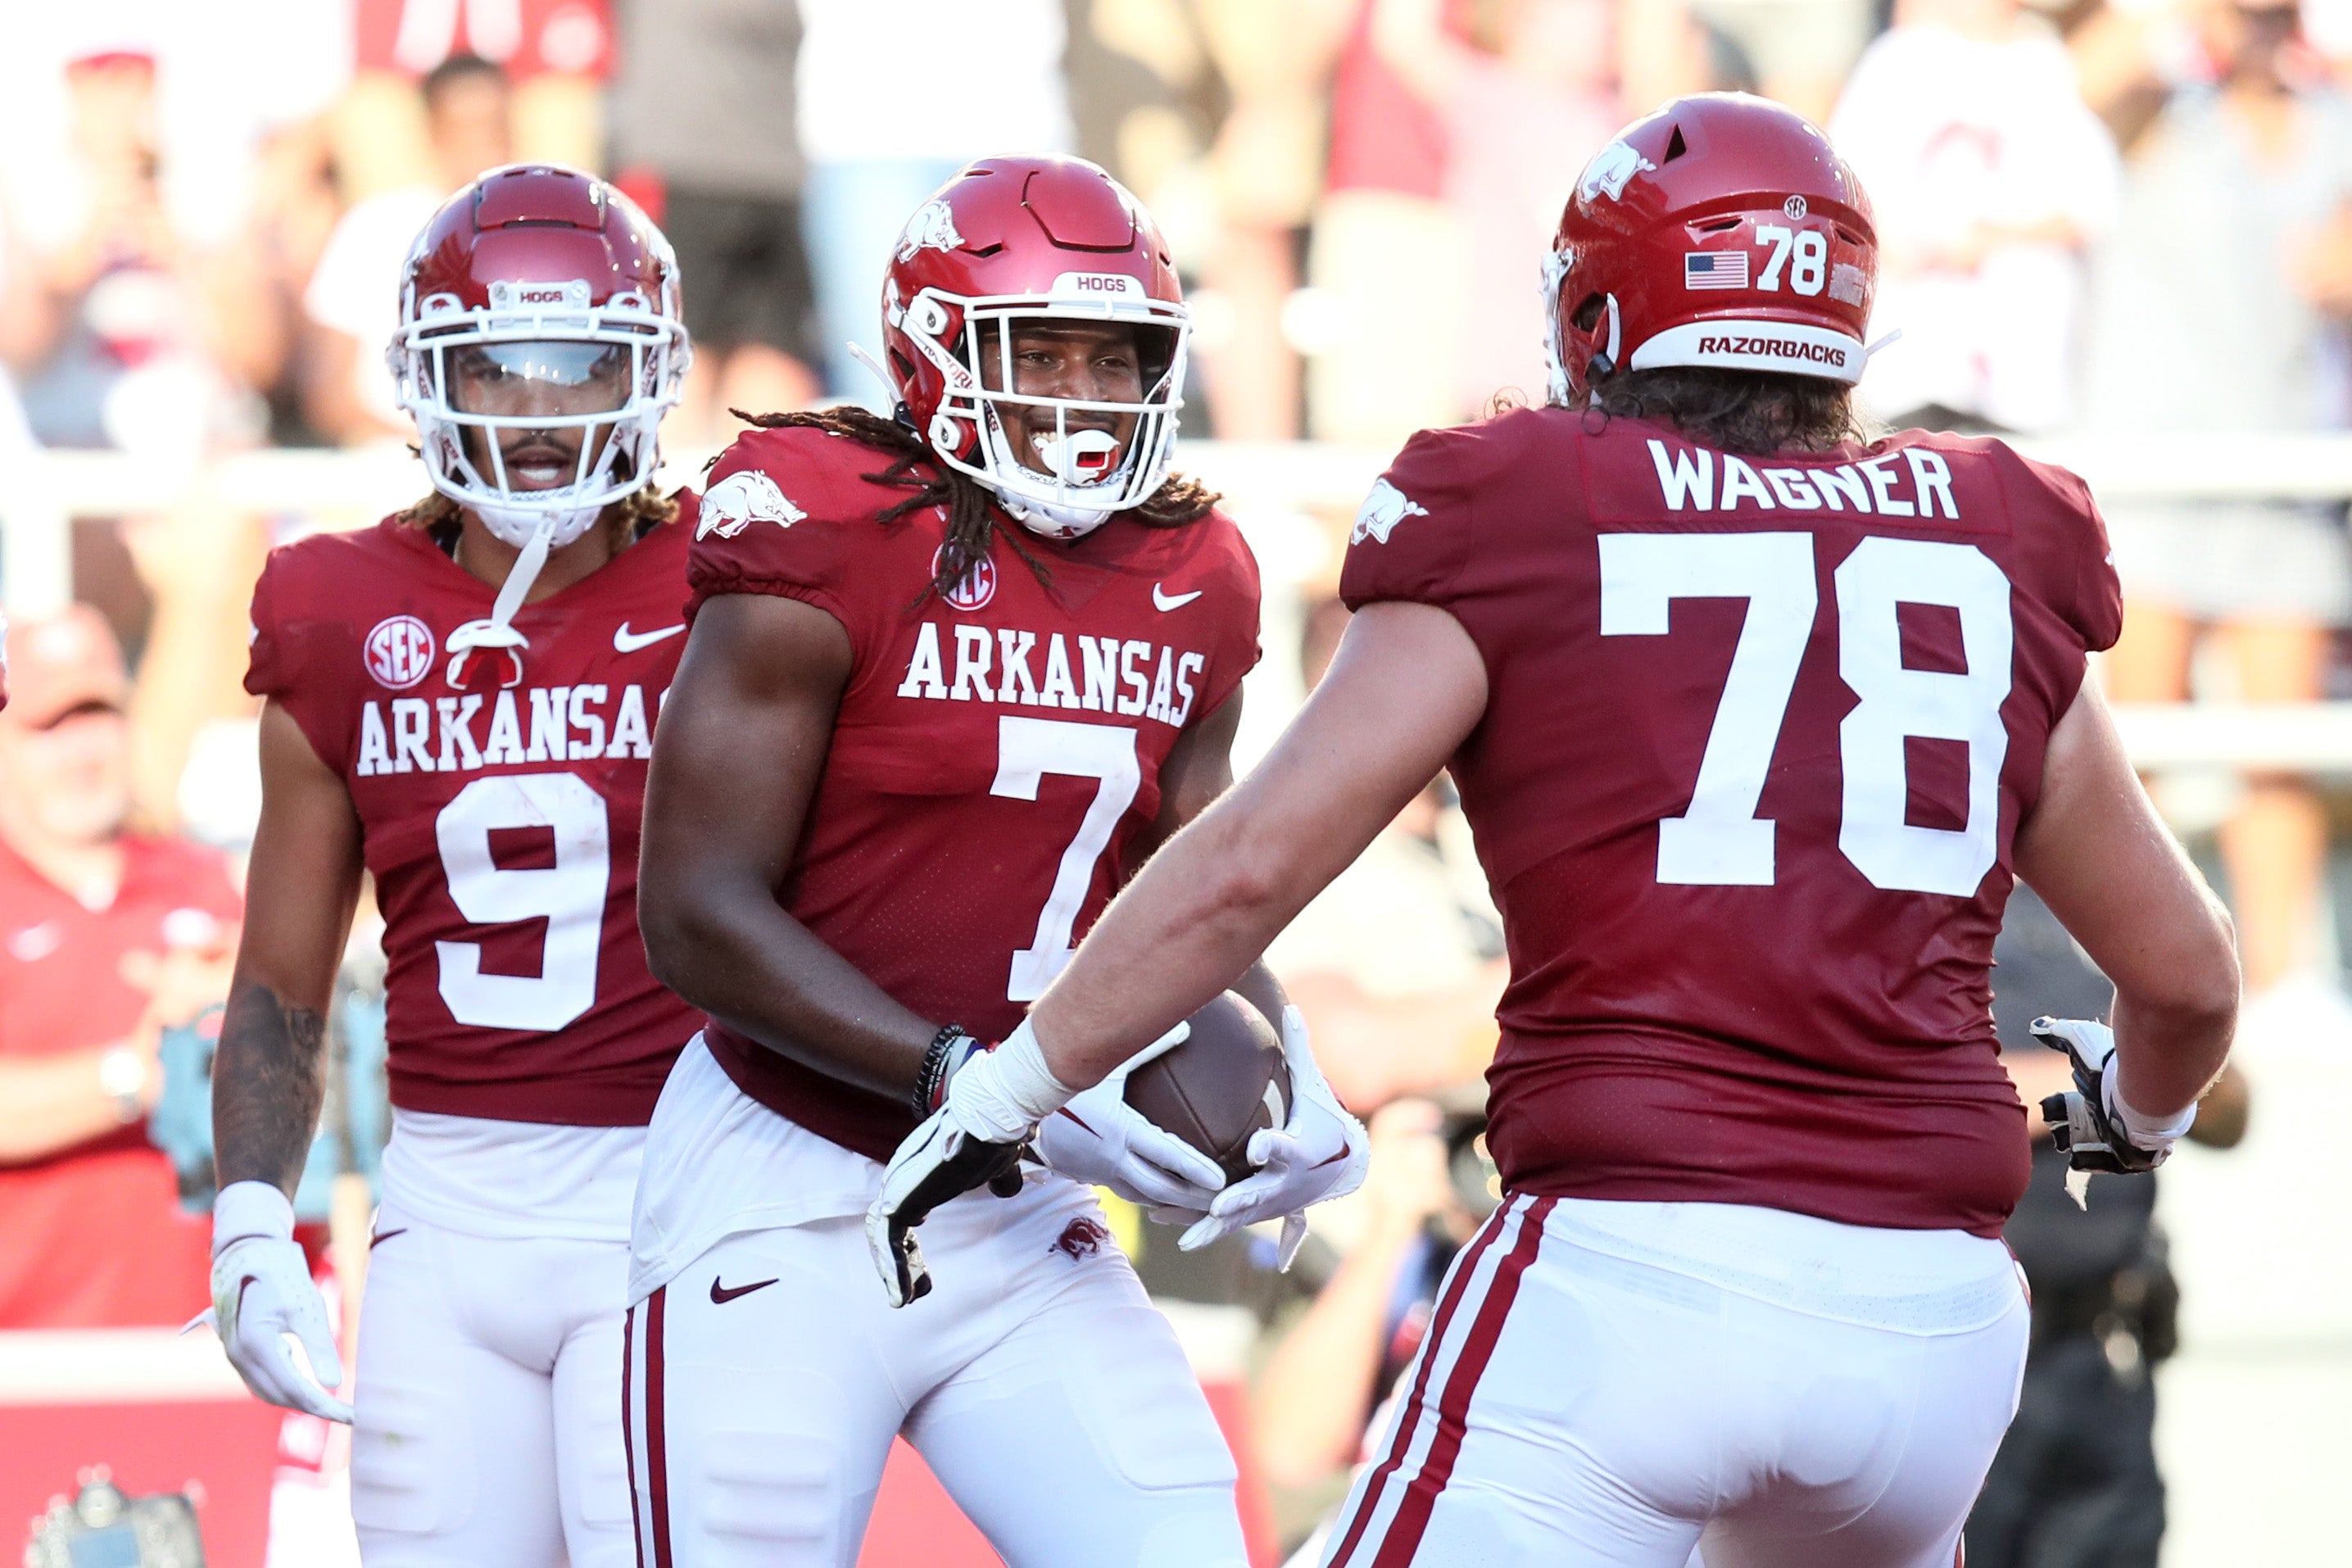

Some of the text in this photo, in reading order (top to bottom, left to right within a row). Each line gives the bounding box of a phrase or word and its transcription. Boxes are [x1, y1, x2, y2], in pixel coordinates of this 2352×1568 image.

[1786, 197, 1806, 219] SEC
[520, 290, 563, 303] HOGS
[1076, 276, 1126, 292] HOGS
[1755, 225, 1828, 297] 78
[1698, 337, 1846, 368] RAZORBACKS
[1647, 438, 1960, 519] WAGNER
[370, 622, 428, 682] SEC
[896, 621, 1205, 728] ARKANSAS
[356, 683, 671, 777] ARKANSA
[1597, 531, 2014, 898] 78
[989, 714, 1142, 1003] 7
[434, 771, 611, 1033] 9
